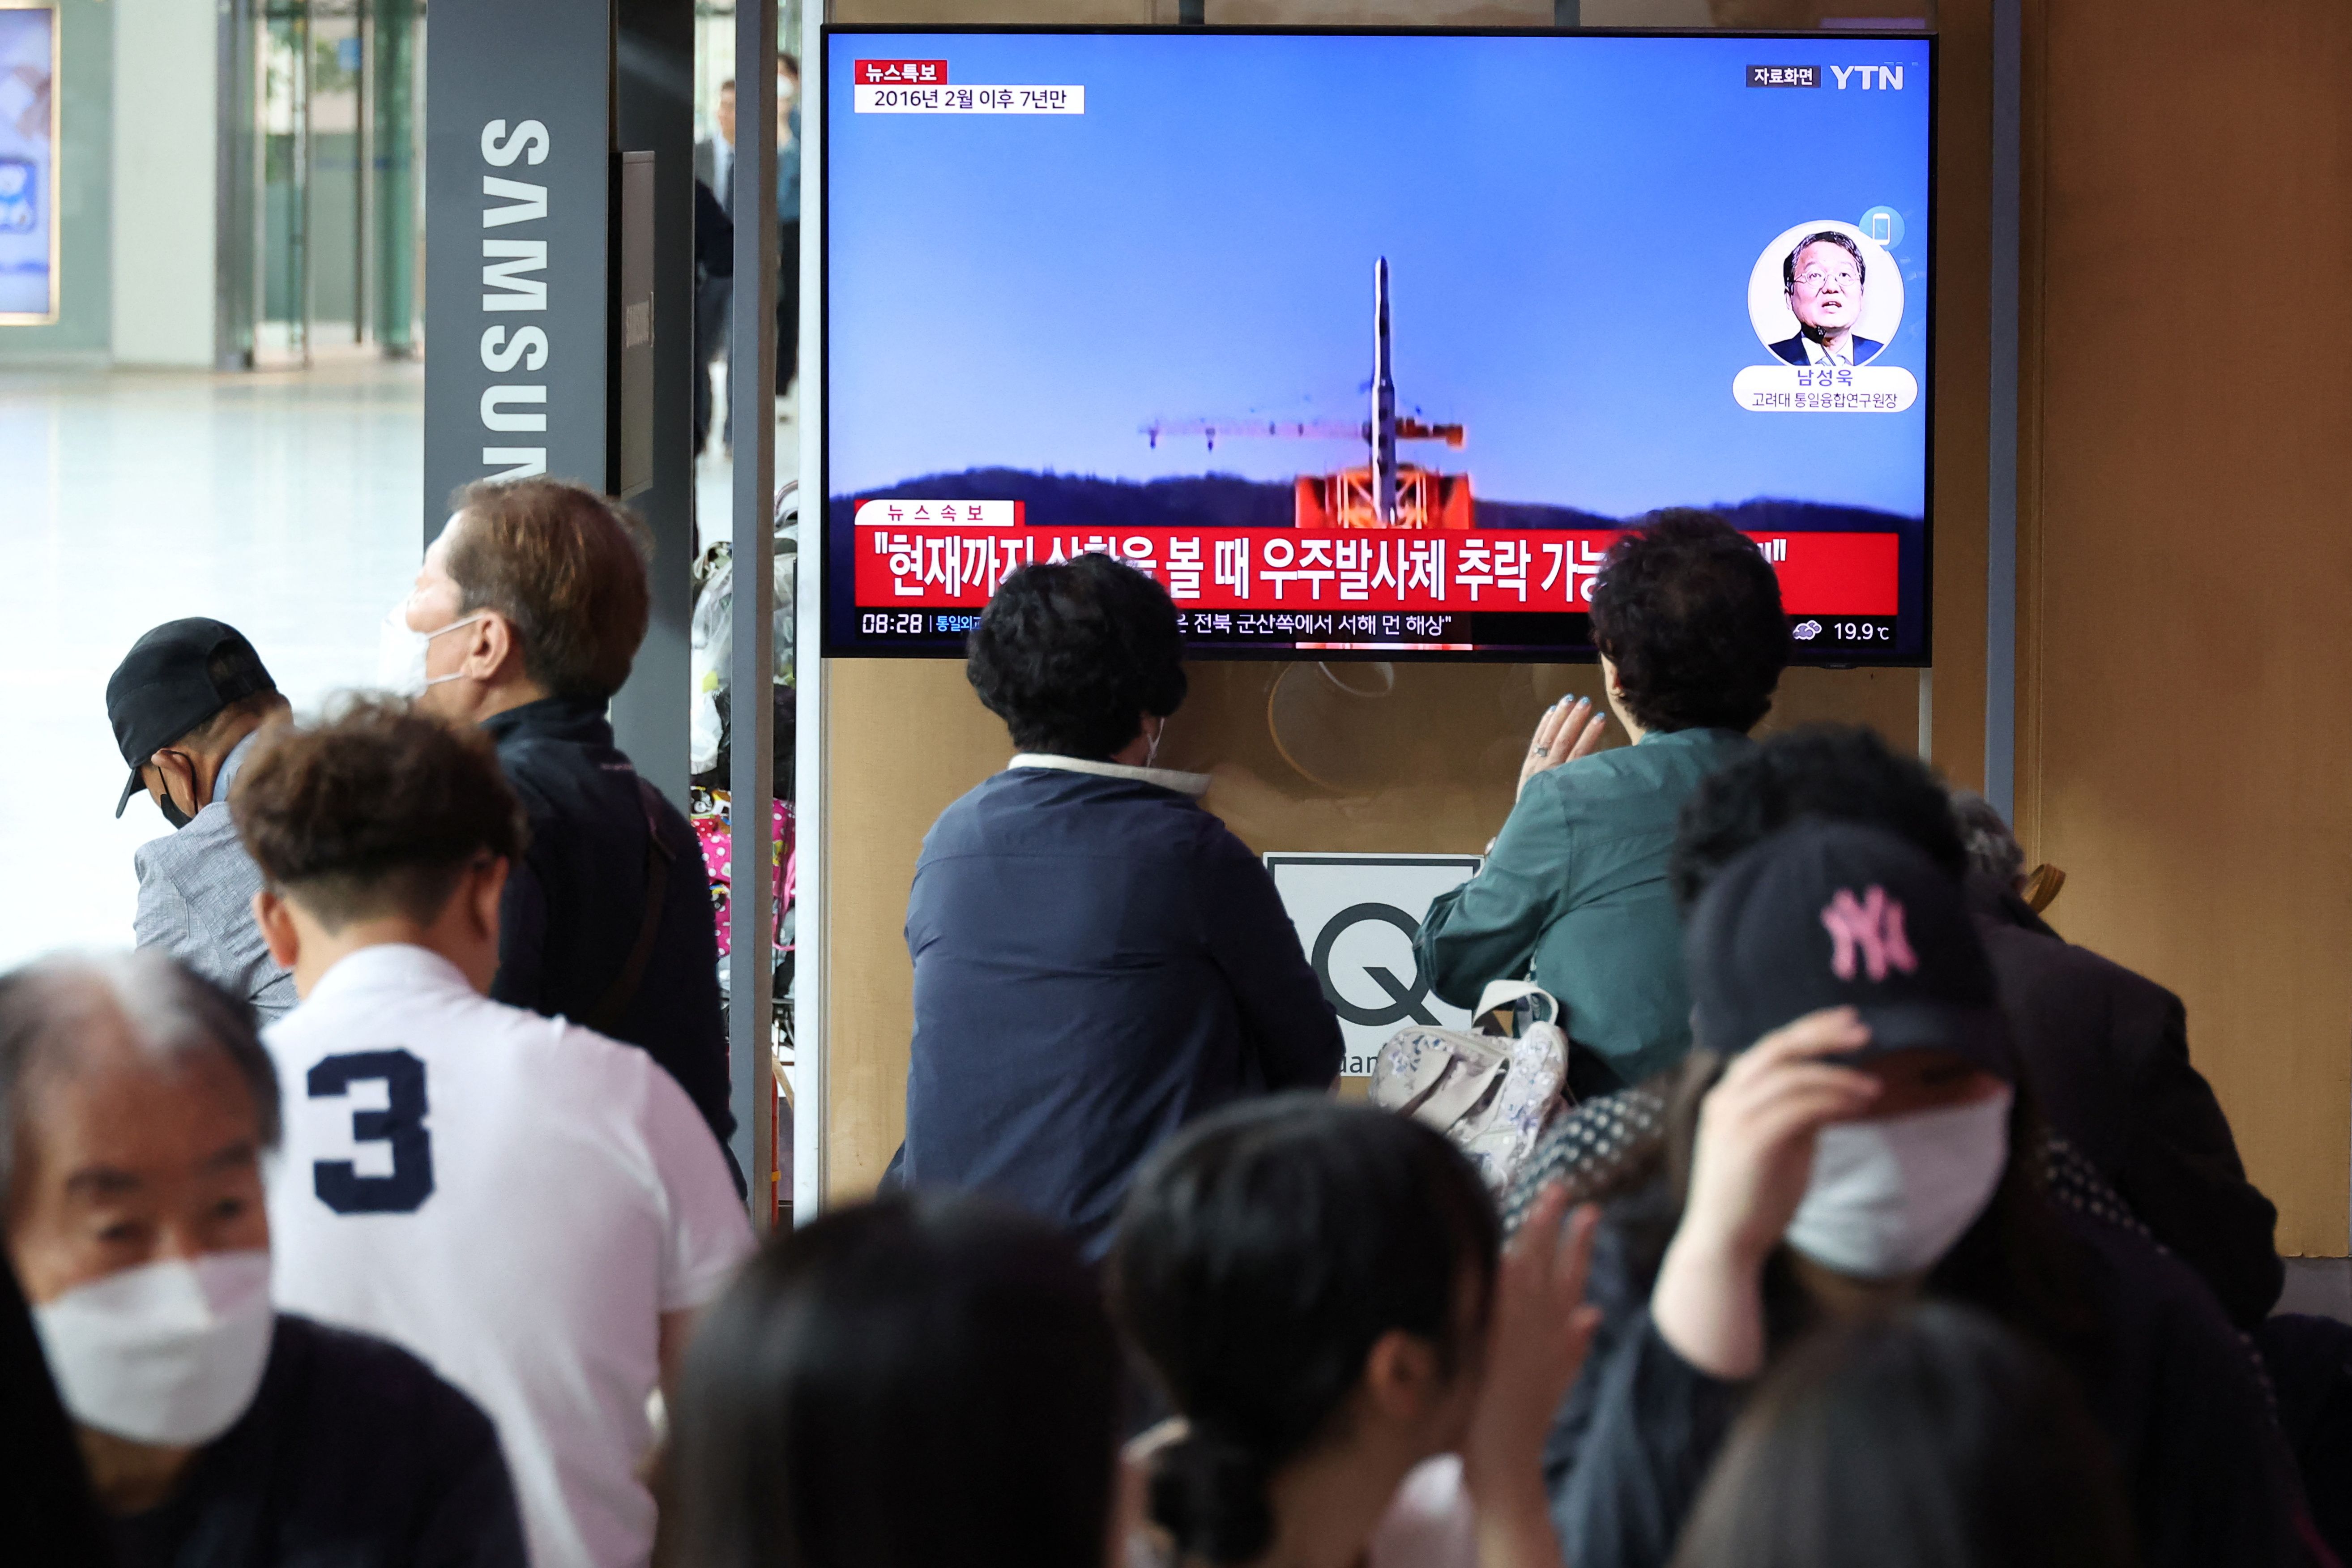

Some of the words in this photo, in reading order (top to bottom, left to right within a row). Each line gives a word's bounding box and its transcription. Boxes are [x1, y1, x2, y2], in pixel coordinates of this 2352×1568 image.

[866, 64, 937, 82] 뉴스특보
[1754, 68, 1813, 85] 자료화면
[1830, 65, 1903, 90] YTN
[875, 90, 938, 109] 2016년
[945, 90, 973, 108] 2월
[979, 89, 1014, 109] 이후
[1020, 90, 1067, 109] 7년만
[1797, 369, 1853, 387] 남성욱
[1752, 393, 1789, 407] 고려대
[1795, 393, 1898, 408] 통일융합연구원장
[1166, 536, 1204, 599] 볼
[1215, 537, 1250, 599] 때
[1260, 538, 1445, 601] 우주발사체
[1456, 538, 1532, 602] 추락
[862, 614, 922, 633] 08:28
[1194, 613, 1232, 634] 전북
[1237, 614, 1332, 636] 군산쪽에서
[1338, 615, 1377, 636] 서해
[1382, 614, 1400, 636] 먼
[1406, 614, 1451, 637] 해상"
[1311, 902, 1442, 1026] Q
[307, 1047, 437, 1216] 3
